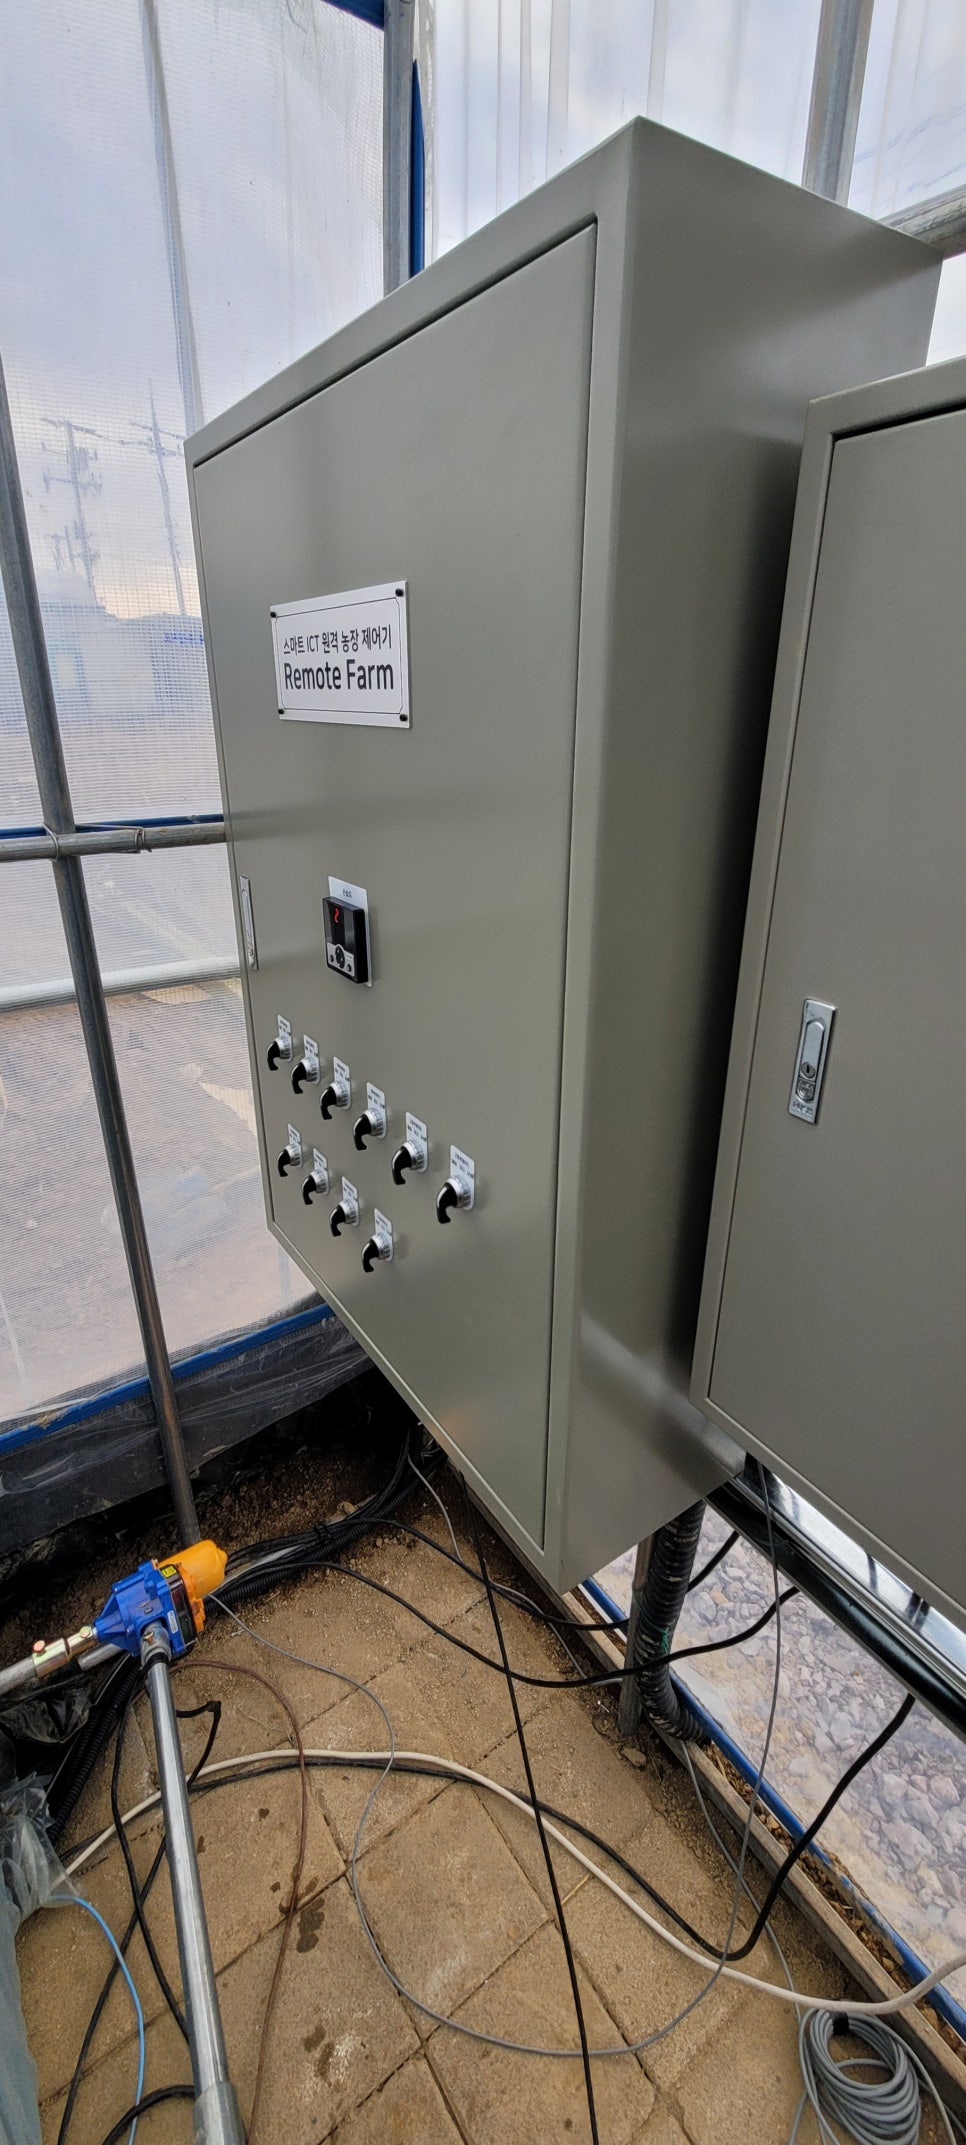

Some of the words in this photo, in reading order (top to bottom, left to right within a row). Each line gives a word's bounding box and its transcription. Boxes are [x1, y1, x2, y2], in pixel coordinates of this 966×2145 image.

[284, 636, 305, 656] 스마트
[307, 635, 320, 652] ICT
[322, 631, 339, 654] 원격
[341, 628, 359, 653] 농장
[361, 624, 392, 651] 제어기
[284, 661, 342, 690] Remote
[346, 659, 394, 690] Farm
